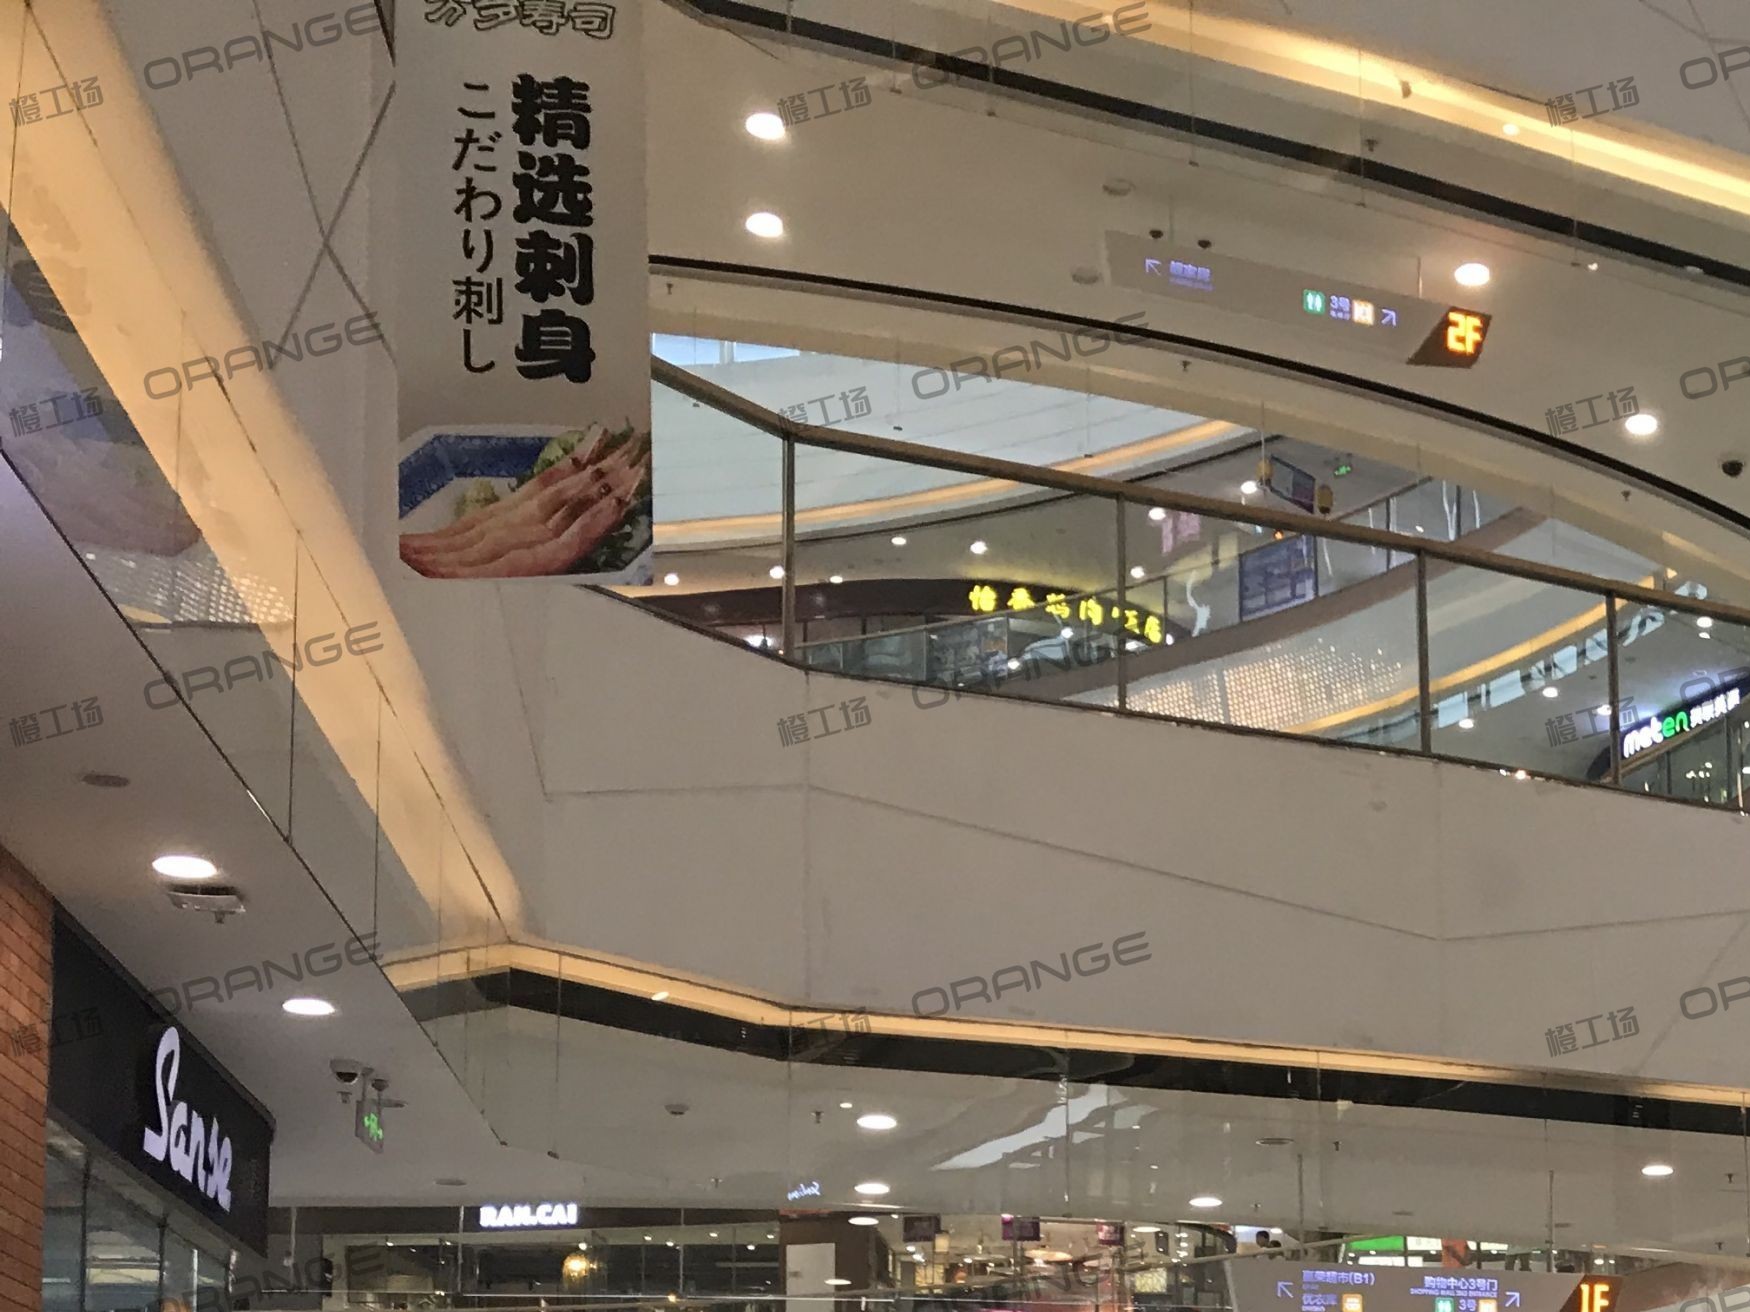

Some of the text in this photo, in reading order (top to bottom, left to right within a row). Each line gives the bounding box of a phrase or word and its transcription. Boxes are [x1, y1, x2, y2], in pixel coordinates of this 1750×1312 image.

[452, 82, 503, 374] こだわり刺し
[511, 73, 596, 384] 精选刺身
[1446, 312, 1482, 355] 2F
[1623, 710, 1690, 758] meten
[1423, 1275, 1498, 1291] 购物中心3号门
